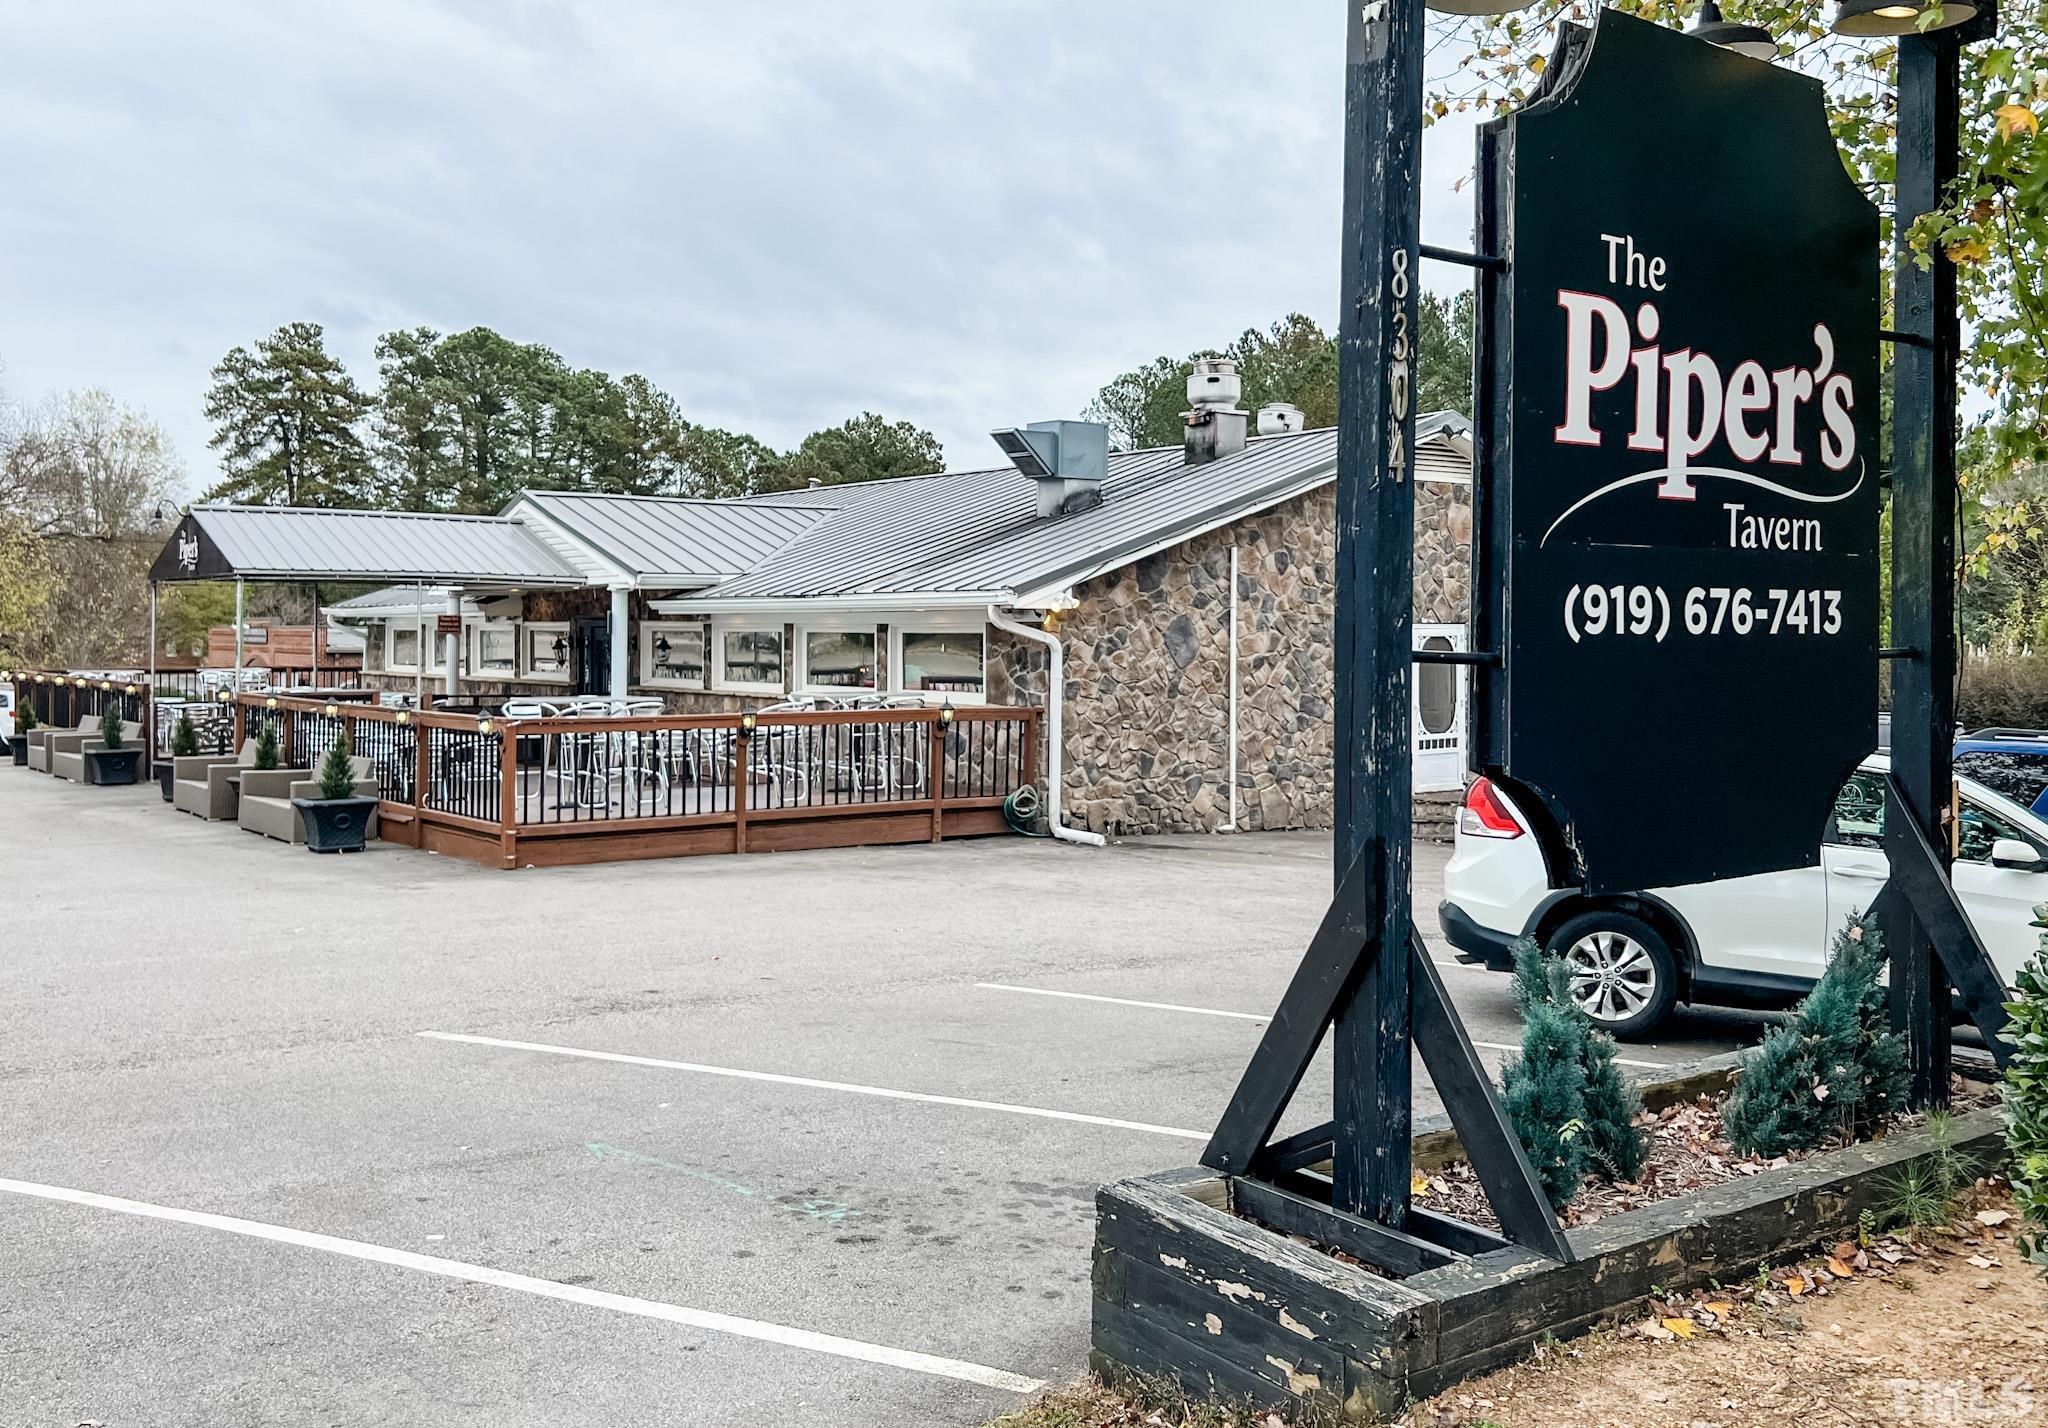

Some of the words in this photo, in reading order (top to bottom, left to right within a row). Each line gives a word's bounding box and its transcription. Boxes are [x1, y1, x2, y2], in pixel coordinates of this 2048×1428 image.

[1601, 233, 1667, 291] The
[1390, 248, 1409, 483] 8304
[1554, 288, 1857, 500] Piper's
[1722, 502, 1823, 552] Tavern
[1564, 583, 1671, 643] (919)
[1684, 586, 1842, 635] 676-7413
